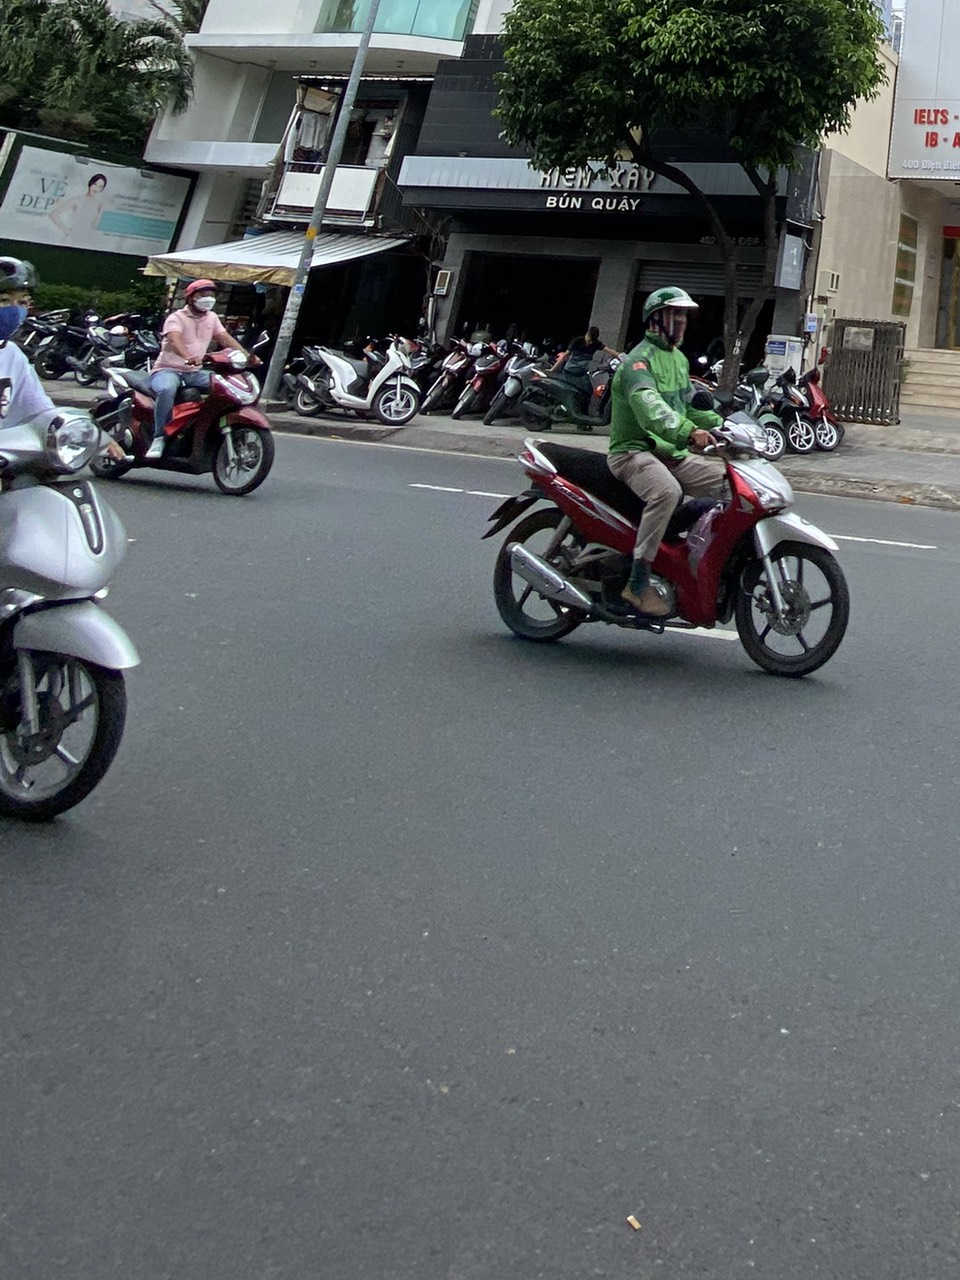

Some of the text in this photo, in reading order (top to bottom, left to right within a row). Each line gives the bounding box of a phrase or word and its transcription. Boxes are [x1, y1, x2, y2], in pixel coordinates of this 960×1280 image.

[913, 109, 949, 125] IELTS
[925, 131, 938, 148] IB
[546, 193, 641, 212] BÚN QUẬY
